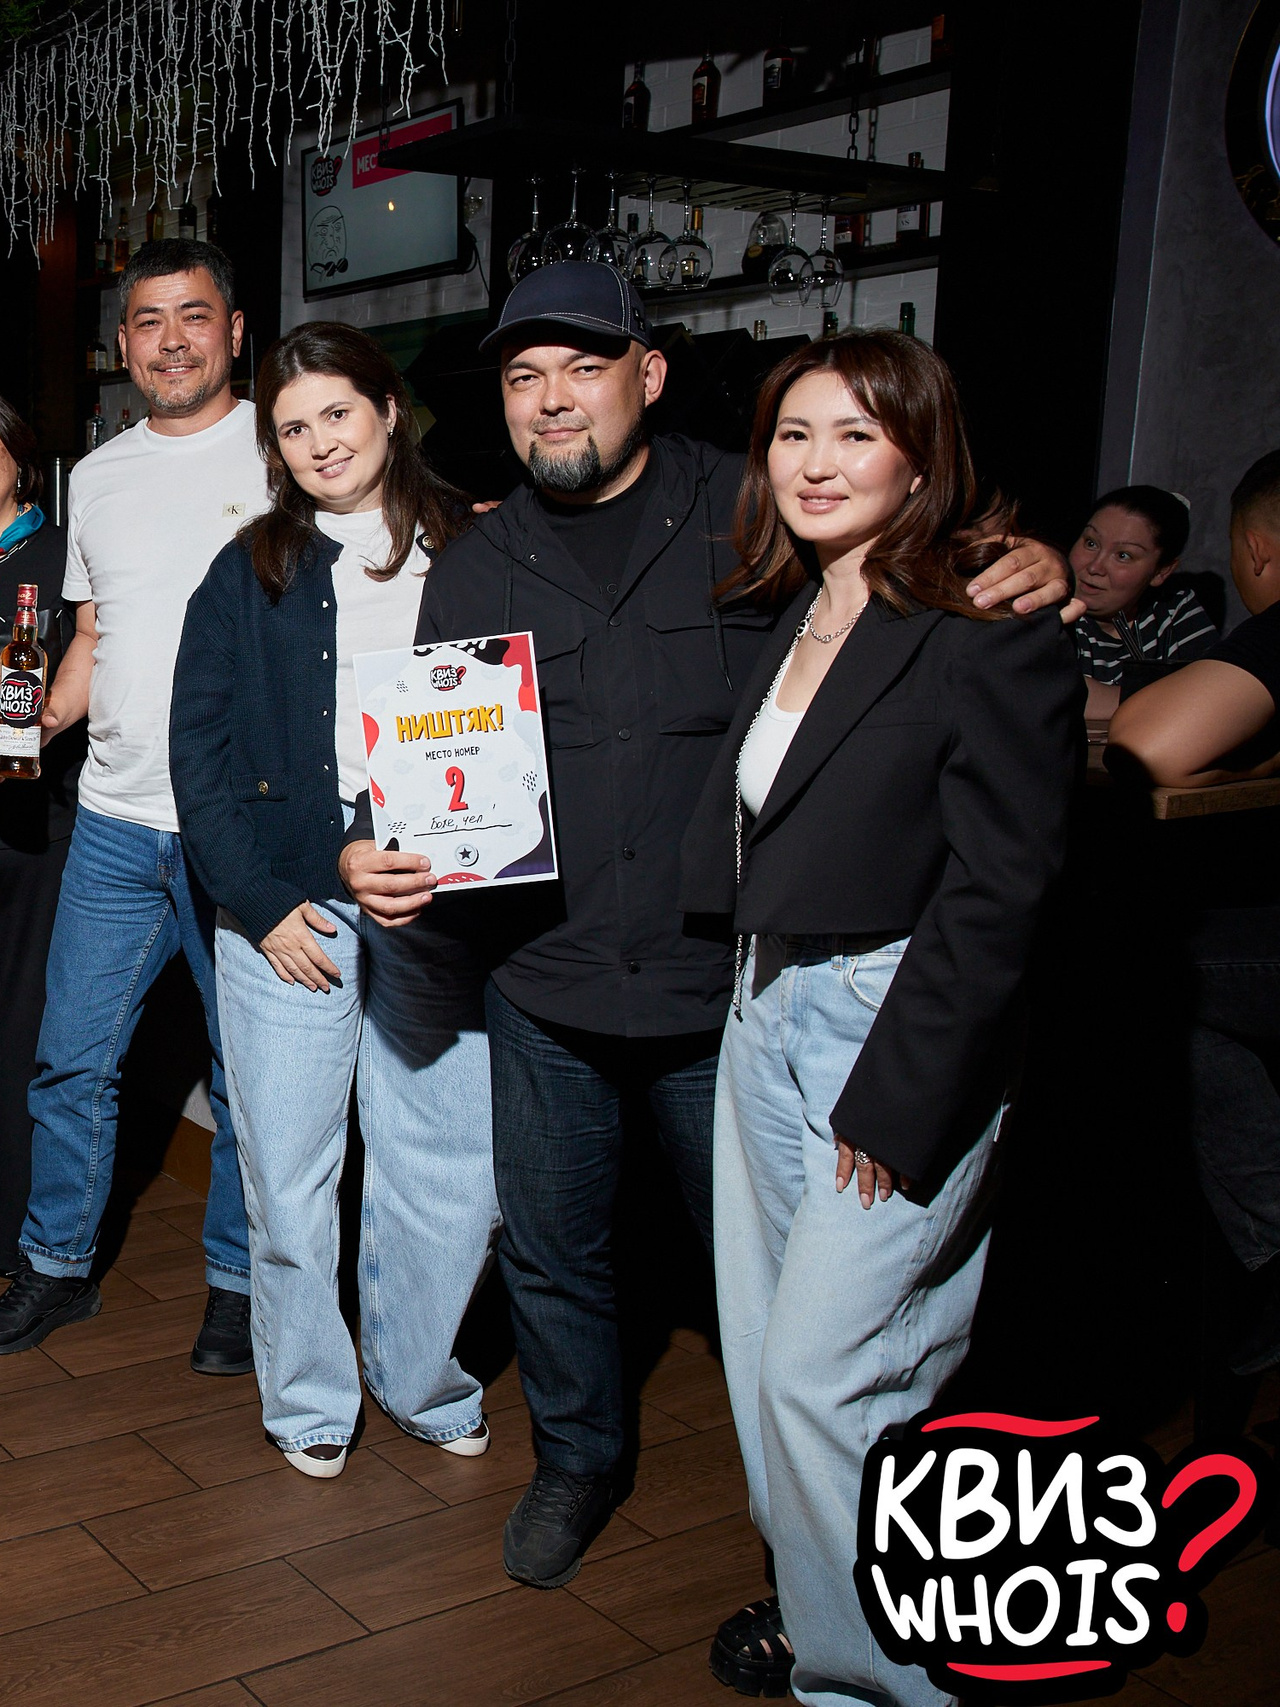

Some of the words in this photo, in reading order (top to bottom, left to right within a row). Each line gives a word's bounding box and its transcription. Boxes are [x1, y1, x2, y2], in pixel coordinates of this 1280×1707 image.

[356, 153, 379, 176] МЕС
[0, 685, 33, 701] КВИЗ
[396, 703, 504, 743] НИШТЯК!
[425, 750, 452, 761] МЕСТО
[455, 746, 480, 758] НОМЕР
[445, 766, 469, 812] 2
